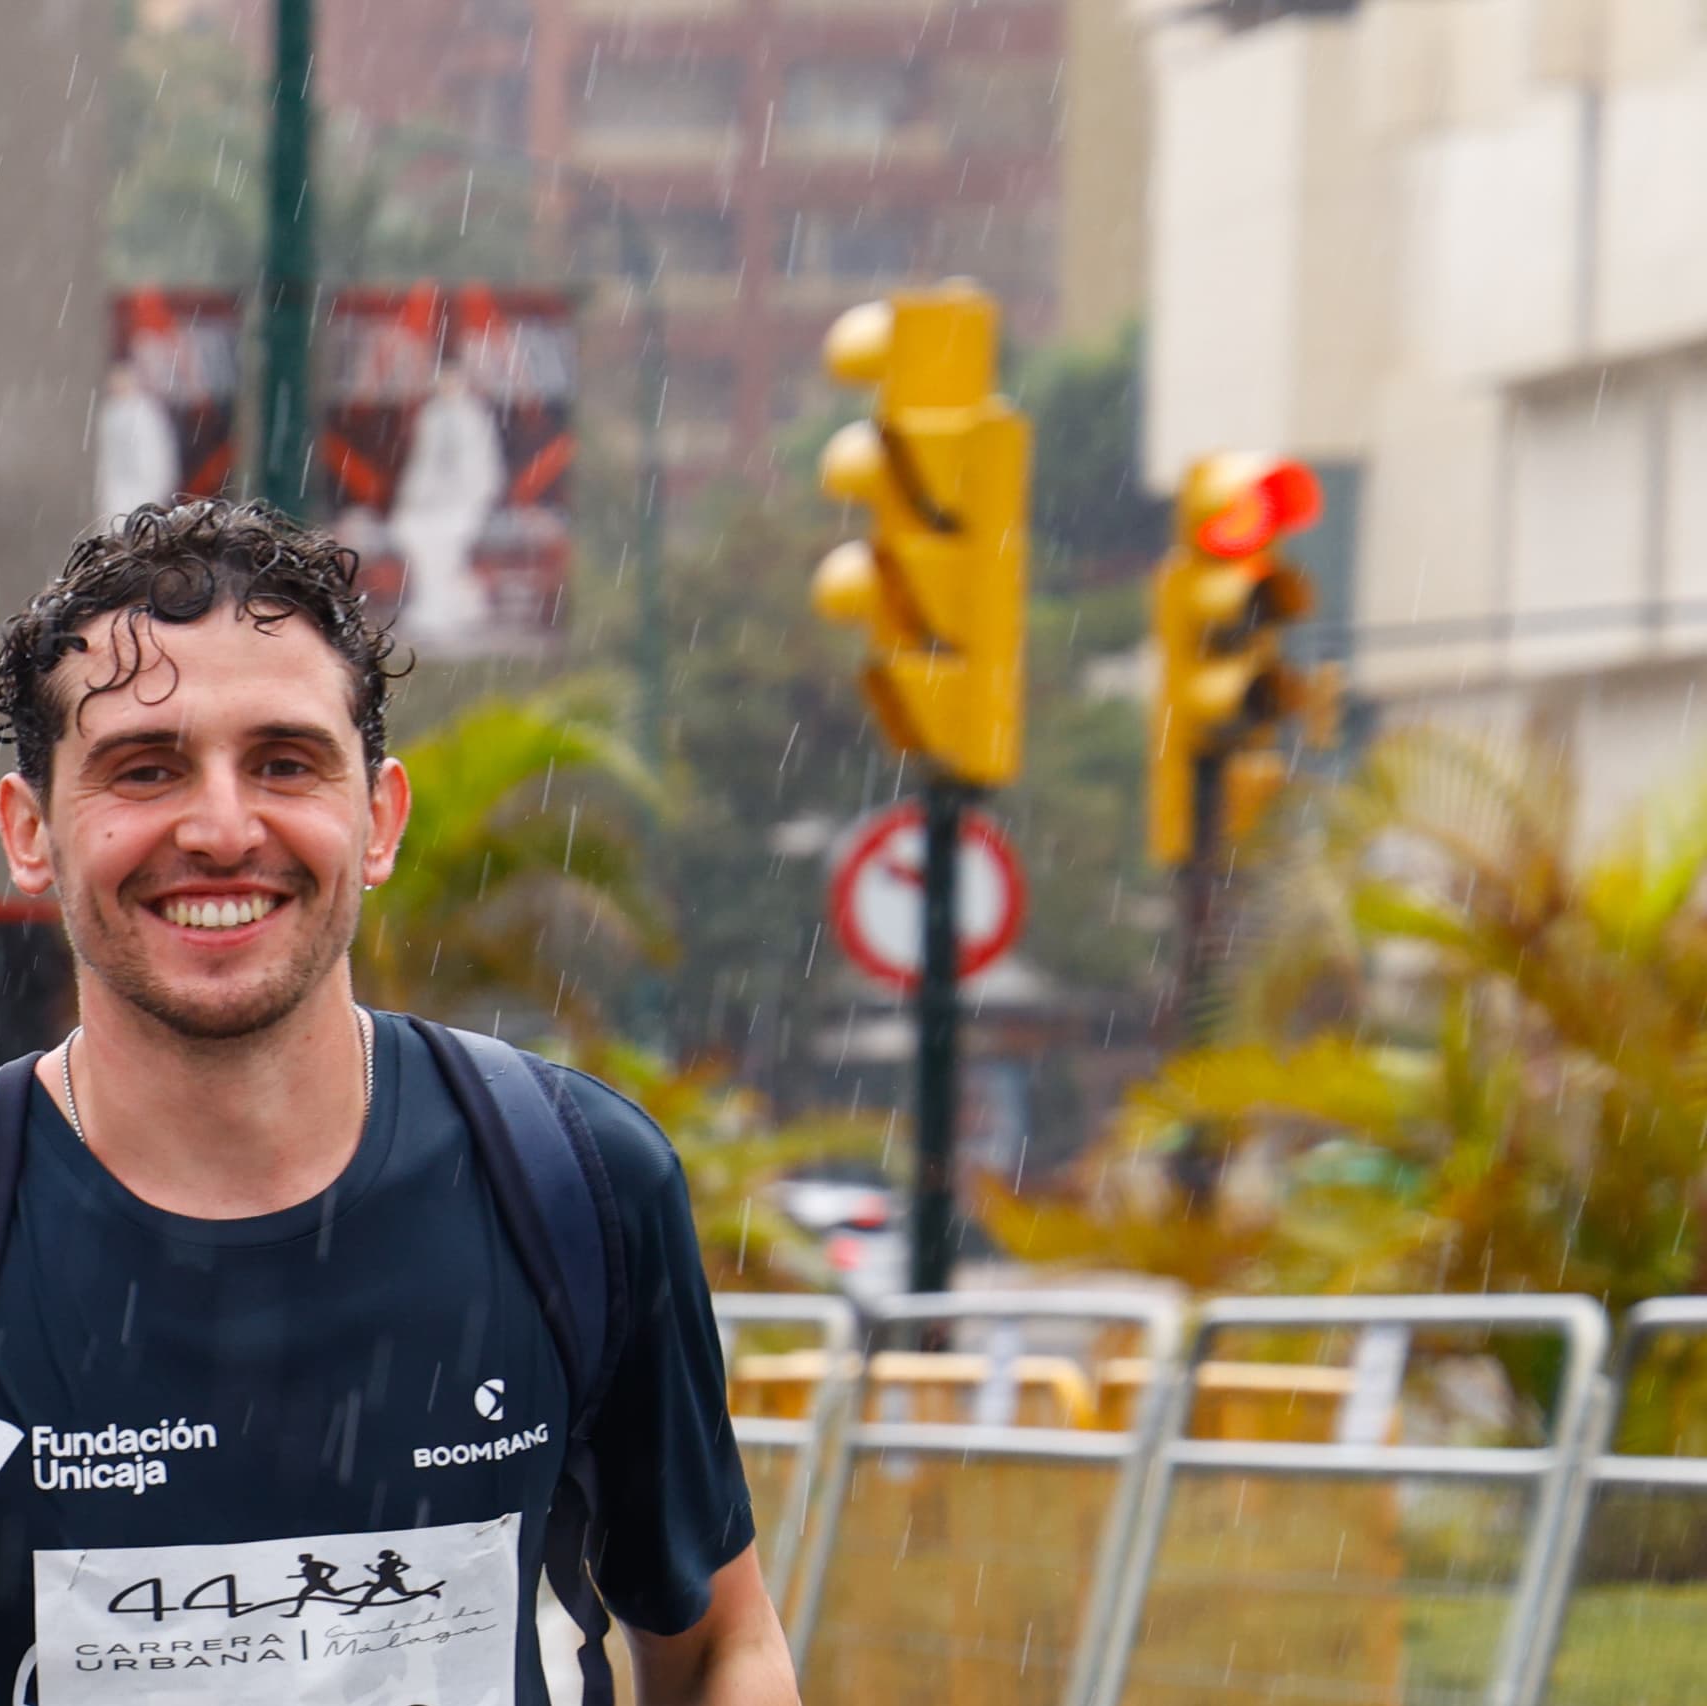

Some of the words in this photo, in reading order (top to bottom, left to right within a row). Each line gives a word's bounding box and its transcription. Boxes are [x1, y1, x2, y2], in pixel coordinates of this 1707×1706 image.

[31, 1417, 217, 1456] Fundación
[33, 1454, 167, 1495] Unicaja
[75, 1633, 284, 1656] CARRERA
[322, 1623, 498, 1658] Málaga
[76, 1649, 286, 1672] URBANA
